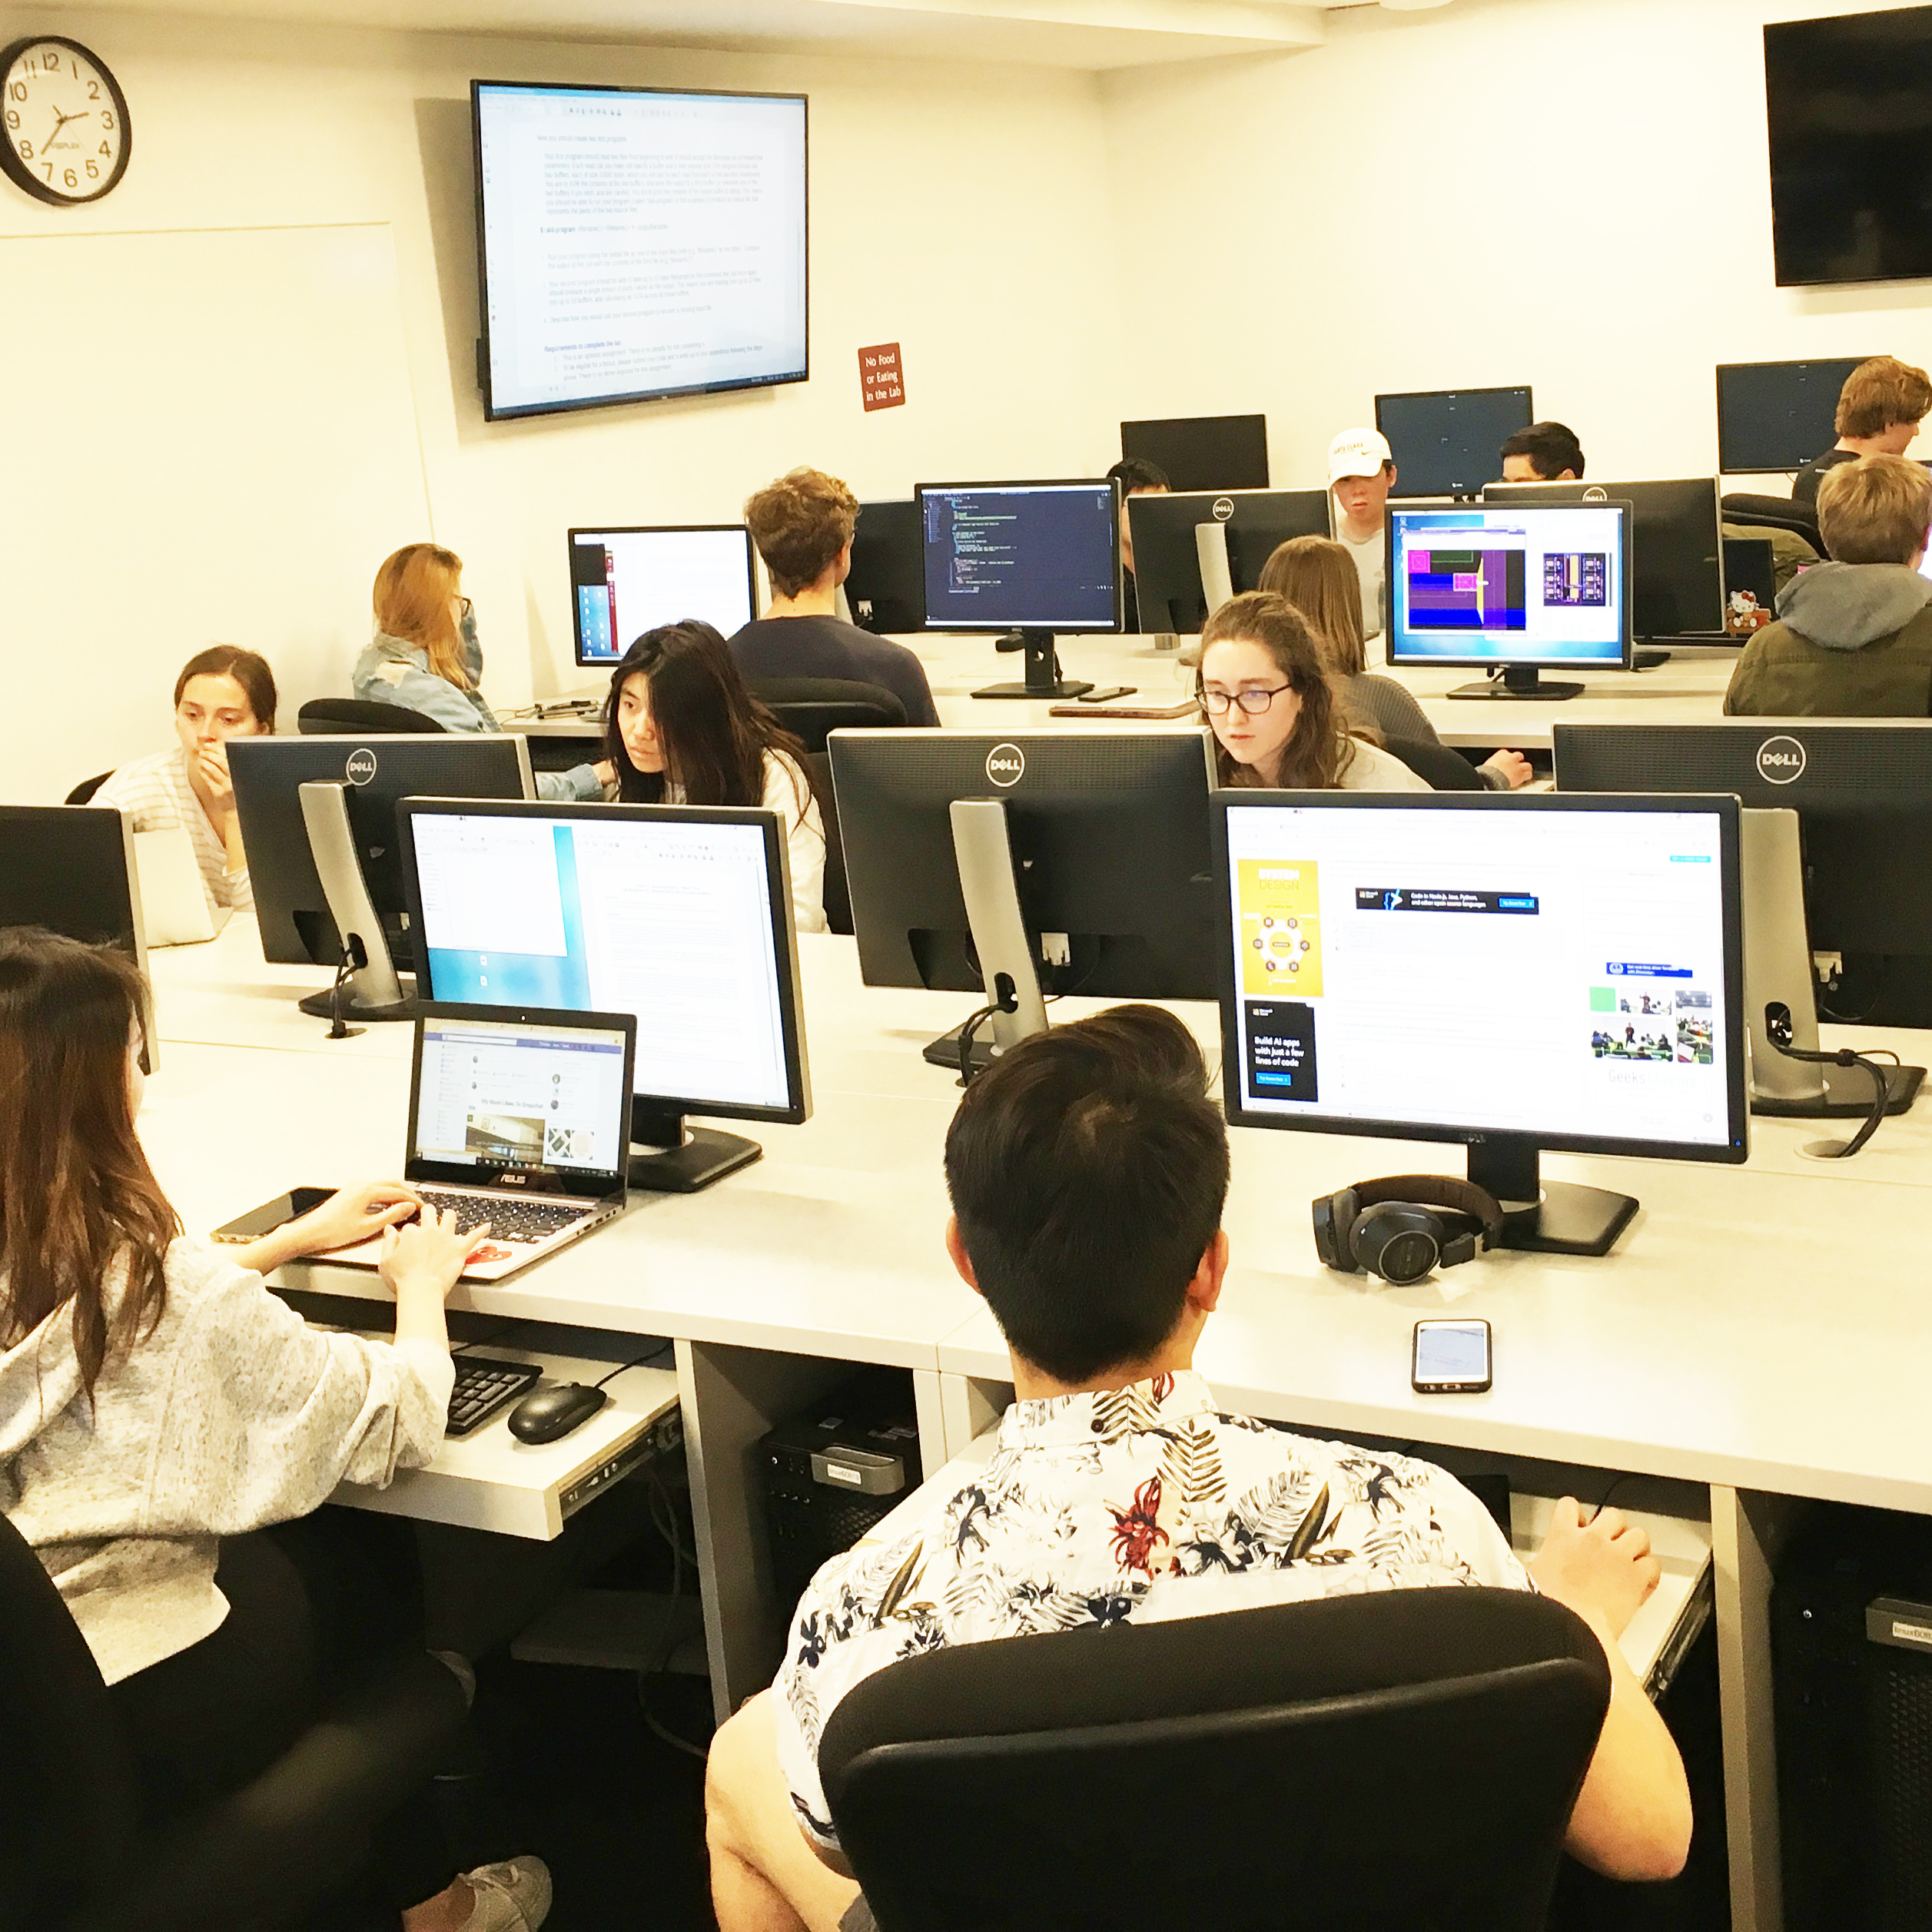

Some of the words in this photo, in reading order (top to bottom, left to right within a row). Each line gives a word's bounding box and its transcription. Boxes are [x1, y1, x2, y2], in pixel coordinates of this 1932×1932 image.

[25, 60, 37, 78] 11
[42, 52, 60, 72] 12
[71, 61, 78, 80] 1
[9, 81, 28, 101] 10
[87, 81, 100, 100] 2
[6, 110, 20, 130] 9
[101, 111, 115, 130] 3
[19, 141, 34, 160] 8
[98, 140, 111, 158] 4
[41, 162, 53, 182] 7
[85, 160, 99, 178] 5
[64, 168, 78, 188] 6
[865, 357, 876, 367] No
[878, 352, 895, 365] Food
[867, 375, 875, 384] or
[877, 370, 898, 383] Eating
[866, 391, 874, 401] in
[875, 389, 887, 400] the
[889, 385, 901, 398] Lab
[350, 762, 373, 772] DELL
[991, 759, 1021, 771] DELL
[1762, 752, 1800, 766] DELL
[1259, 868, 1300, 880] SYSTEM
[1260, 879, 1299, 890] DESIGN
[1254, 1036, 1273, 1045] Build
[1283, 1039, 1300, 1047] apps
[1255, 1047, 1270, 1055] with
[1271, 1048, 1285, 1057] just
[1291, 1048, 1305, 1057] few
[1255, 1056, 1271, 1065] lines
[1273, 1057, 1281, 1066] of
[1281, 1058, 1300, 1067] code
[1608, 1069, 1645, 1084] Geeks
[500, 1173, 526, 1184] ASUS
